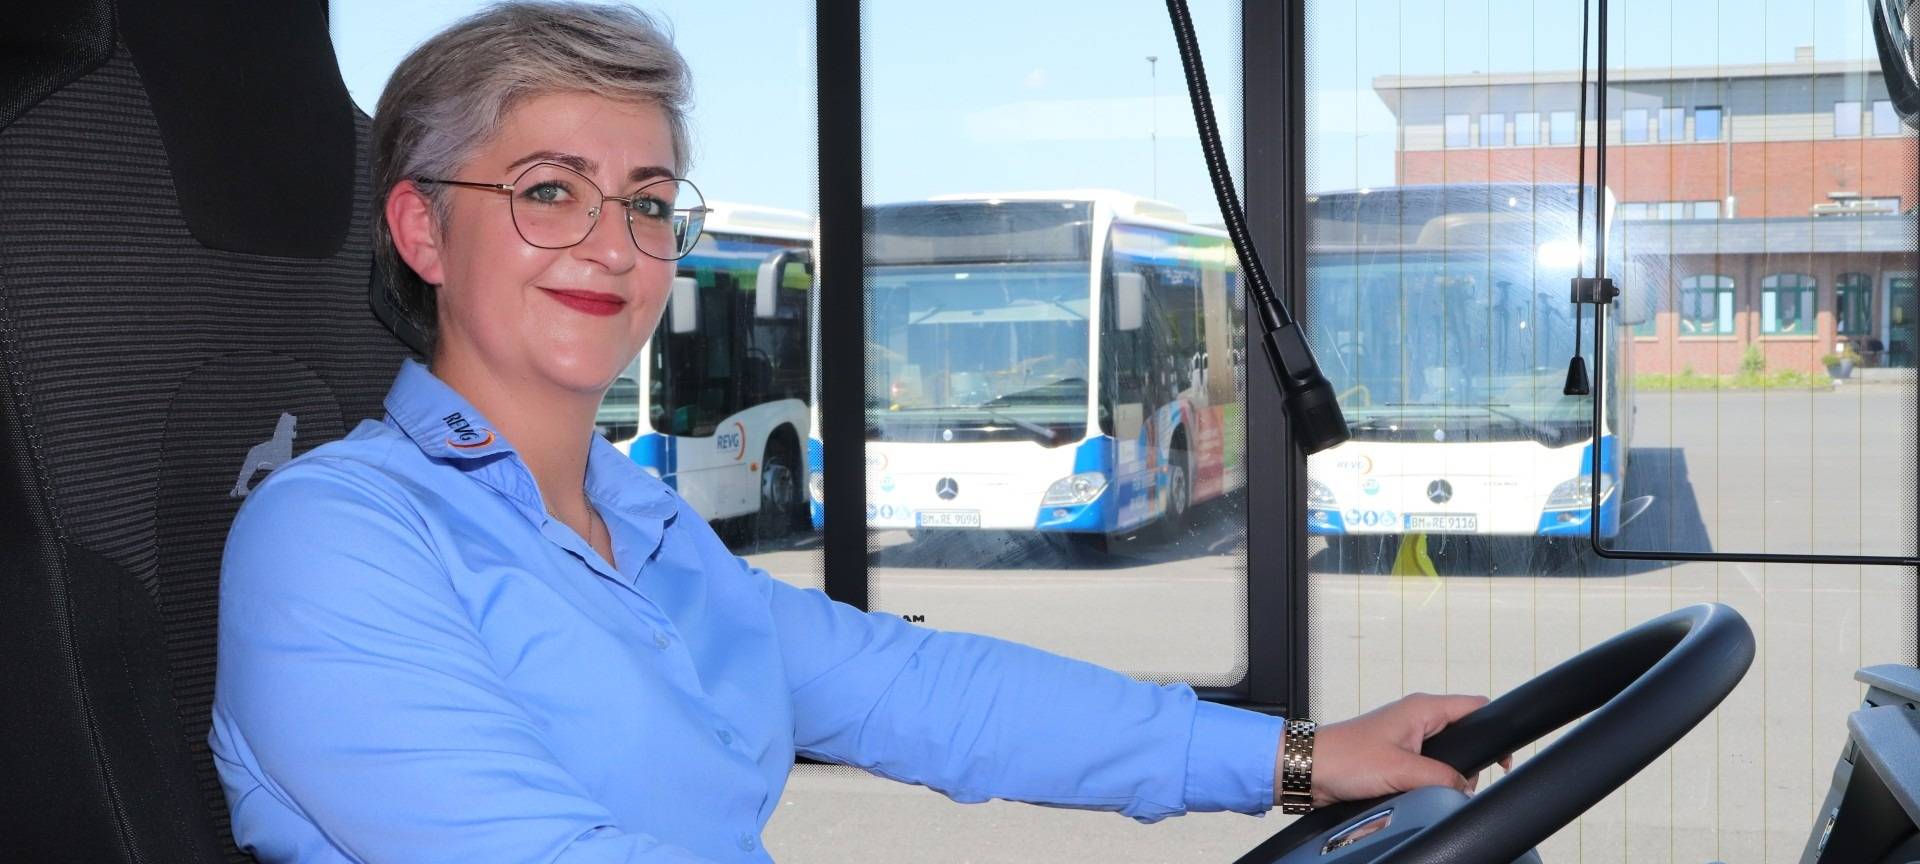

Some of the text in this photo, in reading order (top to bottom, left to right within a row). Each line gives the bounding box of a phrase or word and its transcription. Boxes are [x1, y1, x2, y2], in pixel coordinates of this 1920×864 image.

[443, 412, 480, 441] REVG
[717, 433, 739, 449] REVG
[1448, 517, 1474, 528] 9116
